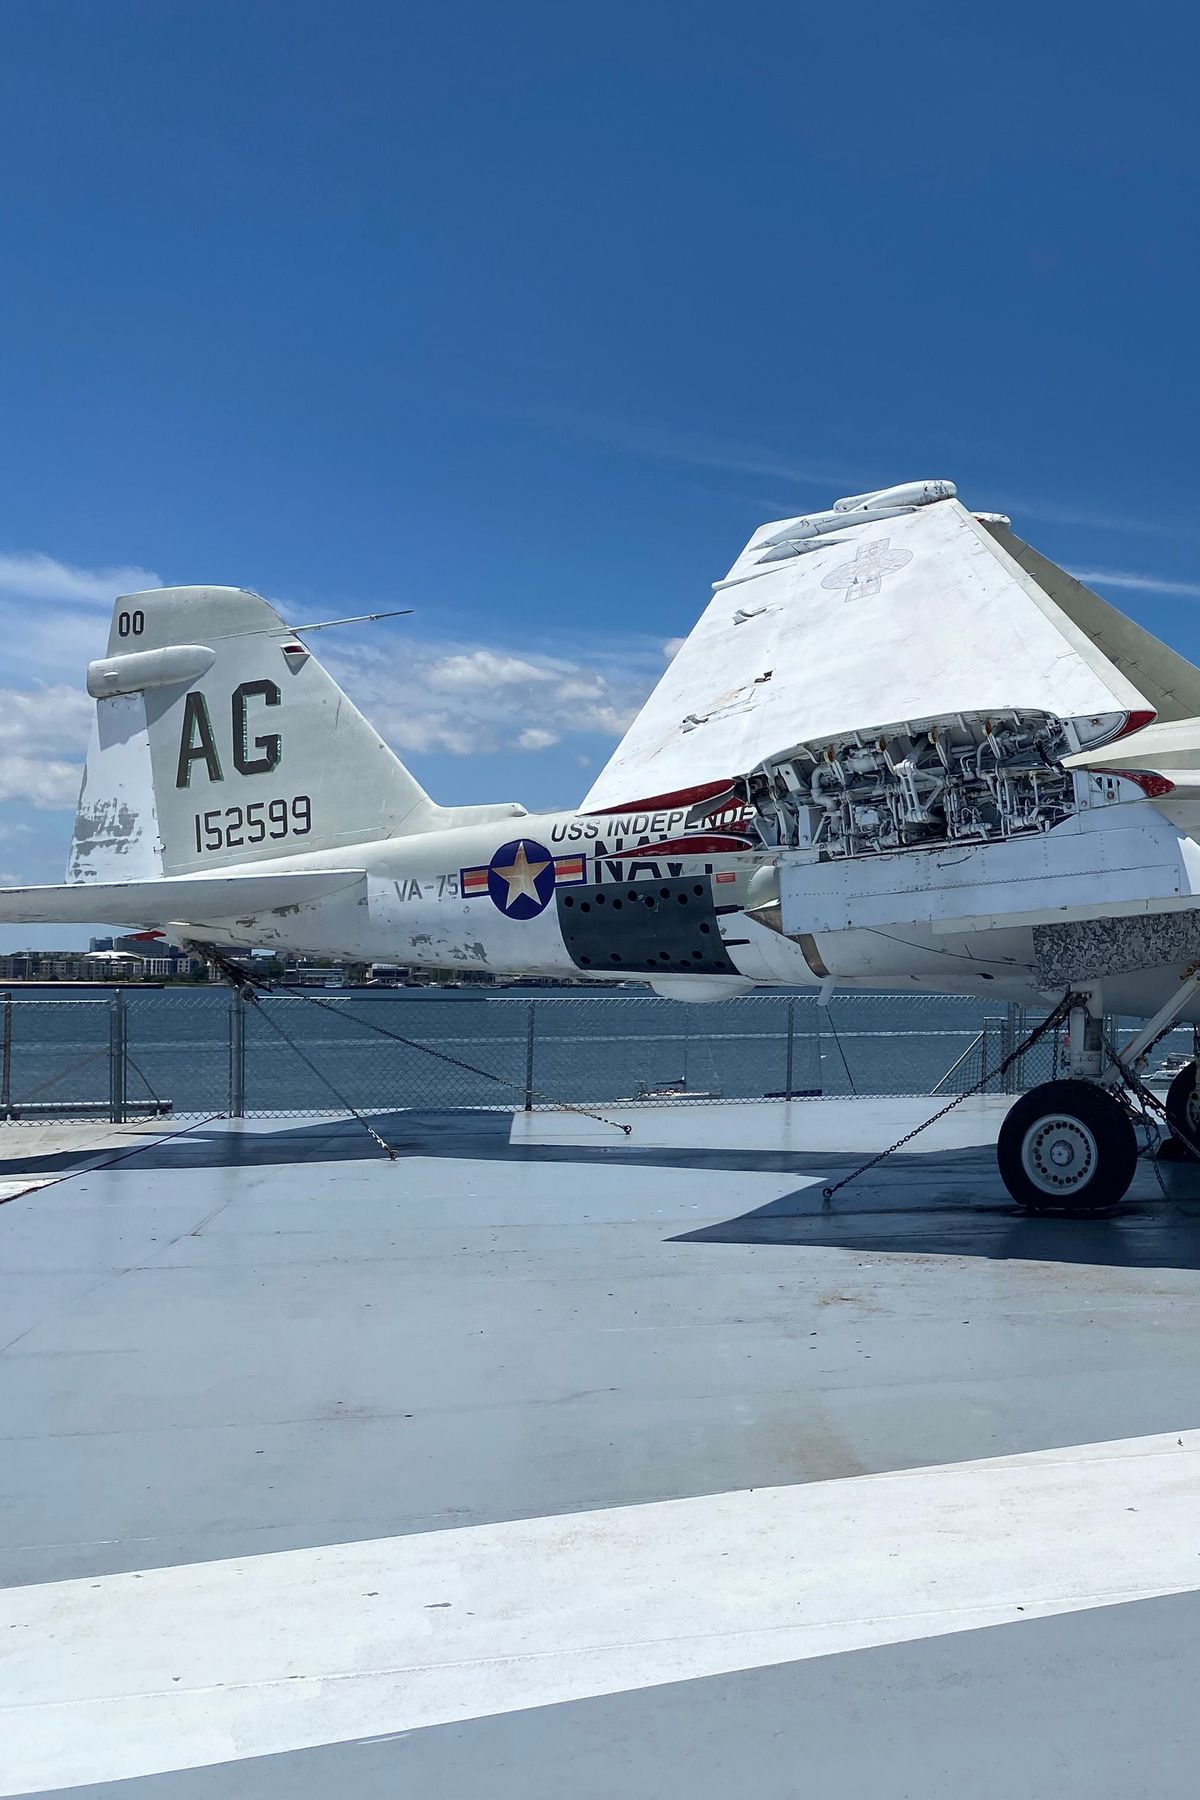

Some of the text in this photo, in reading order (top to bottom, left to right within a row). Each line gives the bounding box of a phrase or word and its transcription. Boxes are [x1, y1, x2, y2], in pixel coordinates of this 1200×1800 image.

[118, 610, 145, 638] 00
[176, 679, 282, 790] AG
[195, 795, 312, 853] 152599
[551, 820, 600, 843] USS
[393, 873, 459, 902] VA-75
